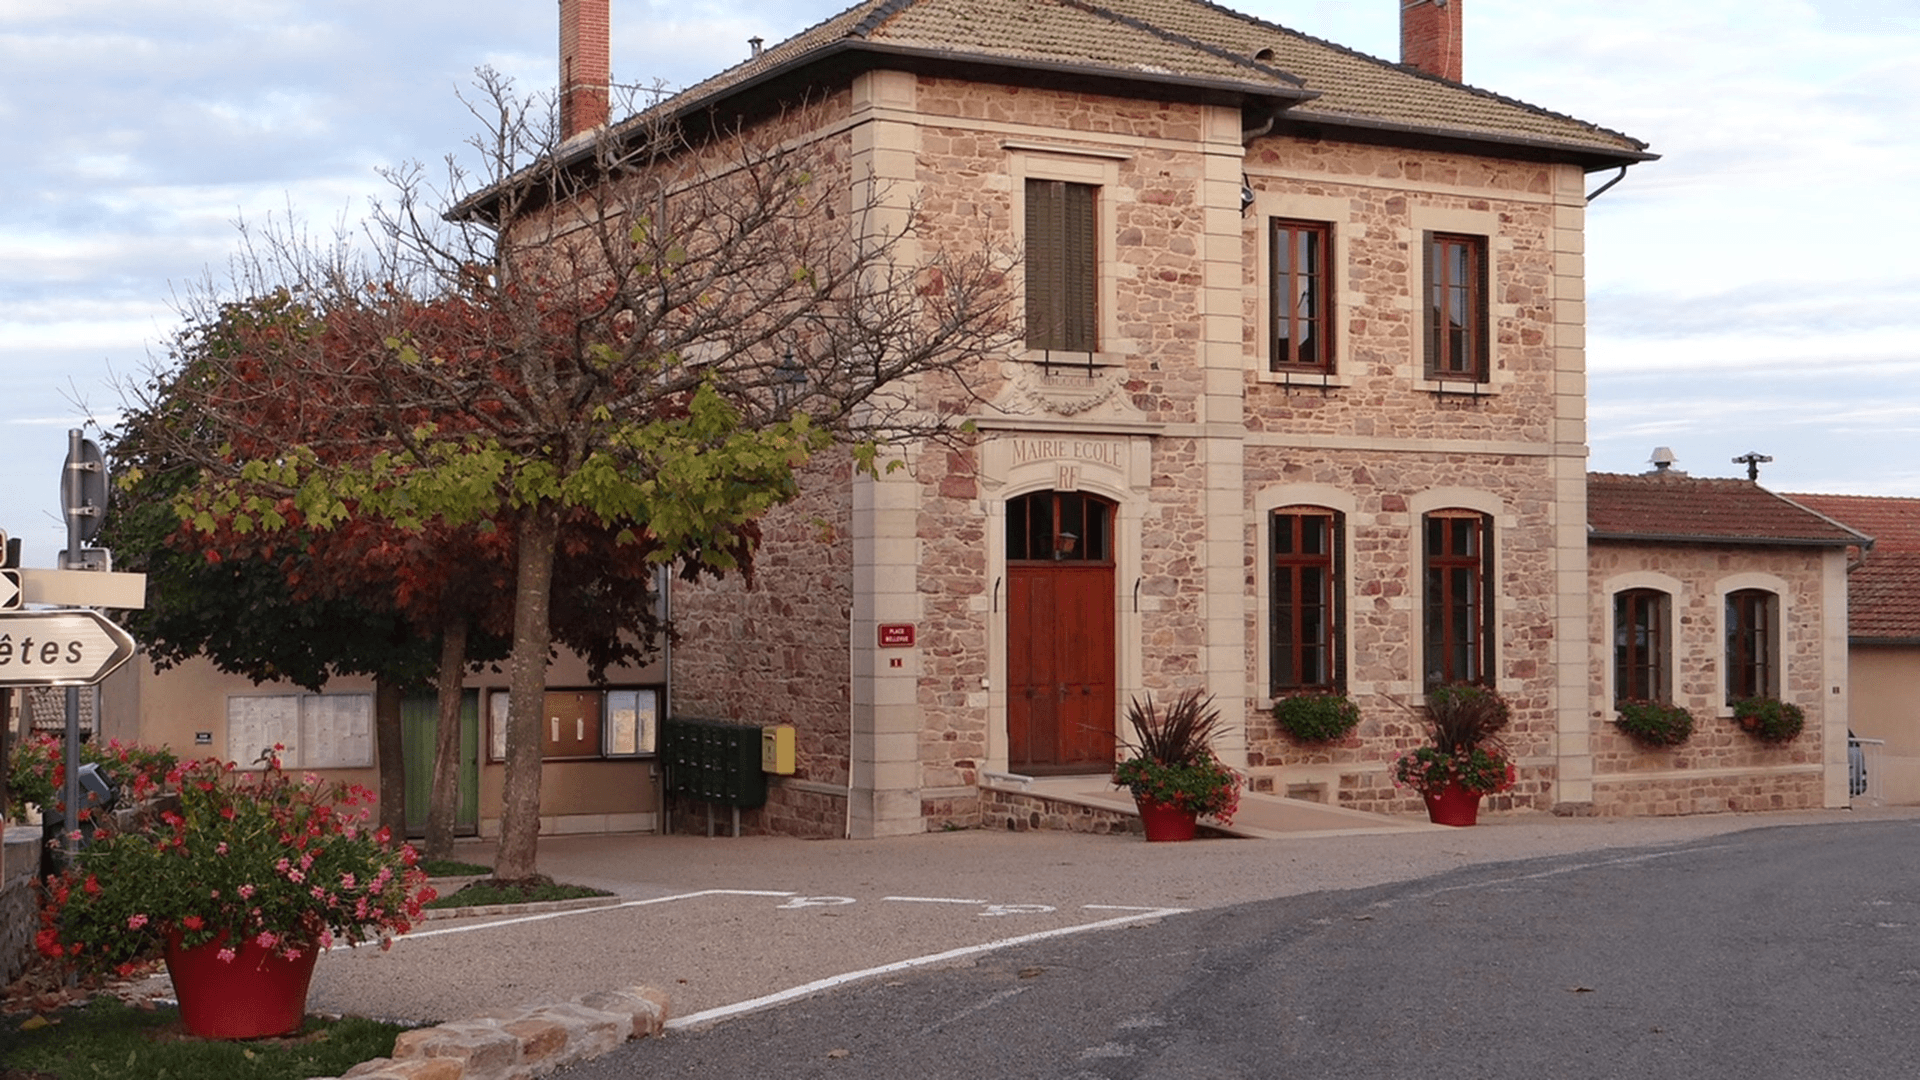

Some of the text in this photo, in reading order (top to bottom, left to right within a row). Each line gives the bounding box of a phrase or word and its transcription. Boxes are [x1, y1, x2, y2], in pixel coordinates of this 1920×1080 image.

[1012, 439, 1122, 468] MAIRIE ECOLE
[1058, 465, 1078, 489] RF
